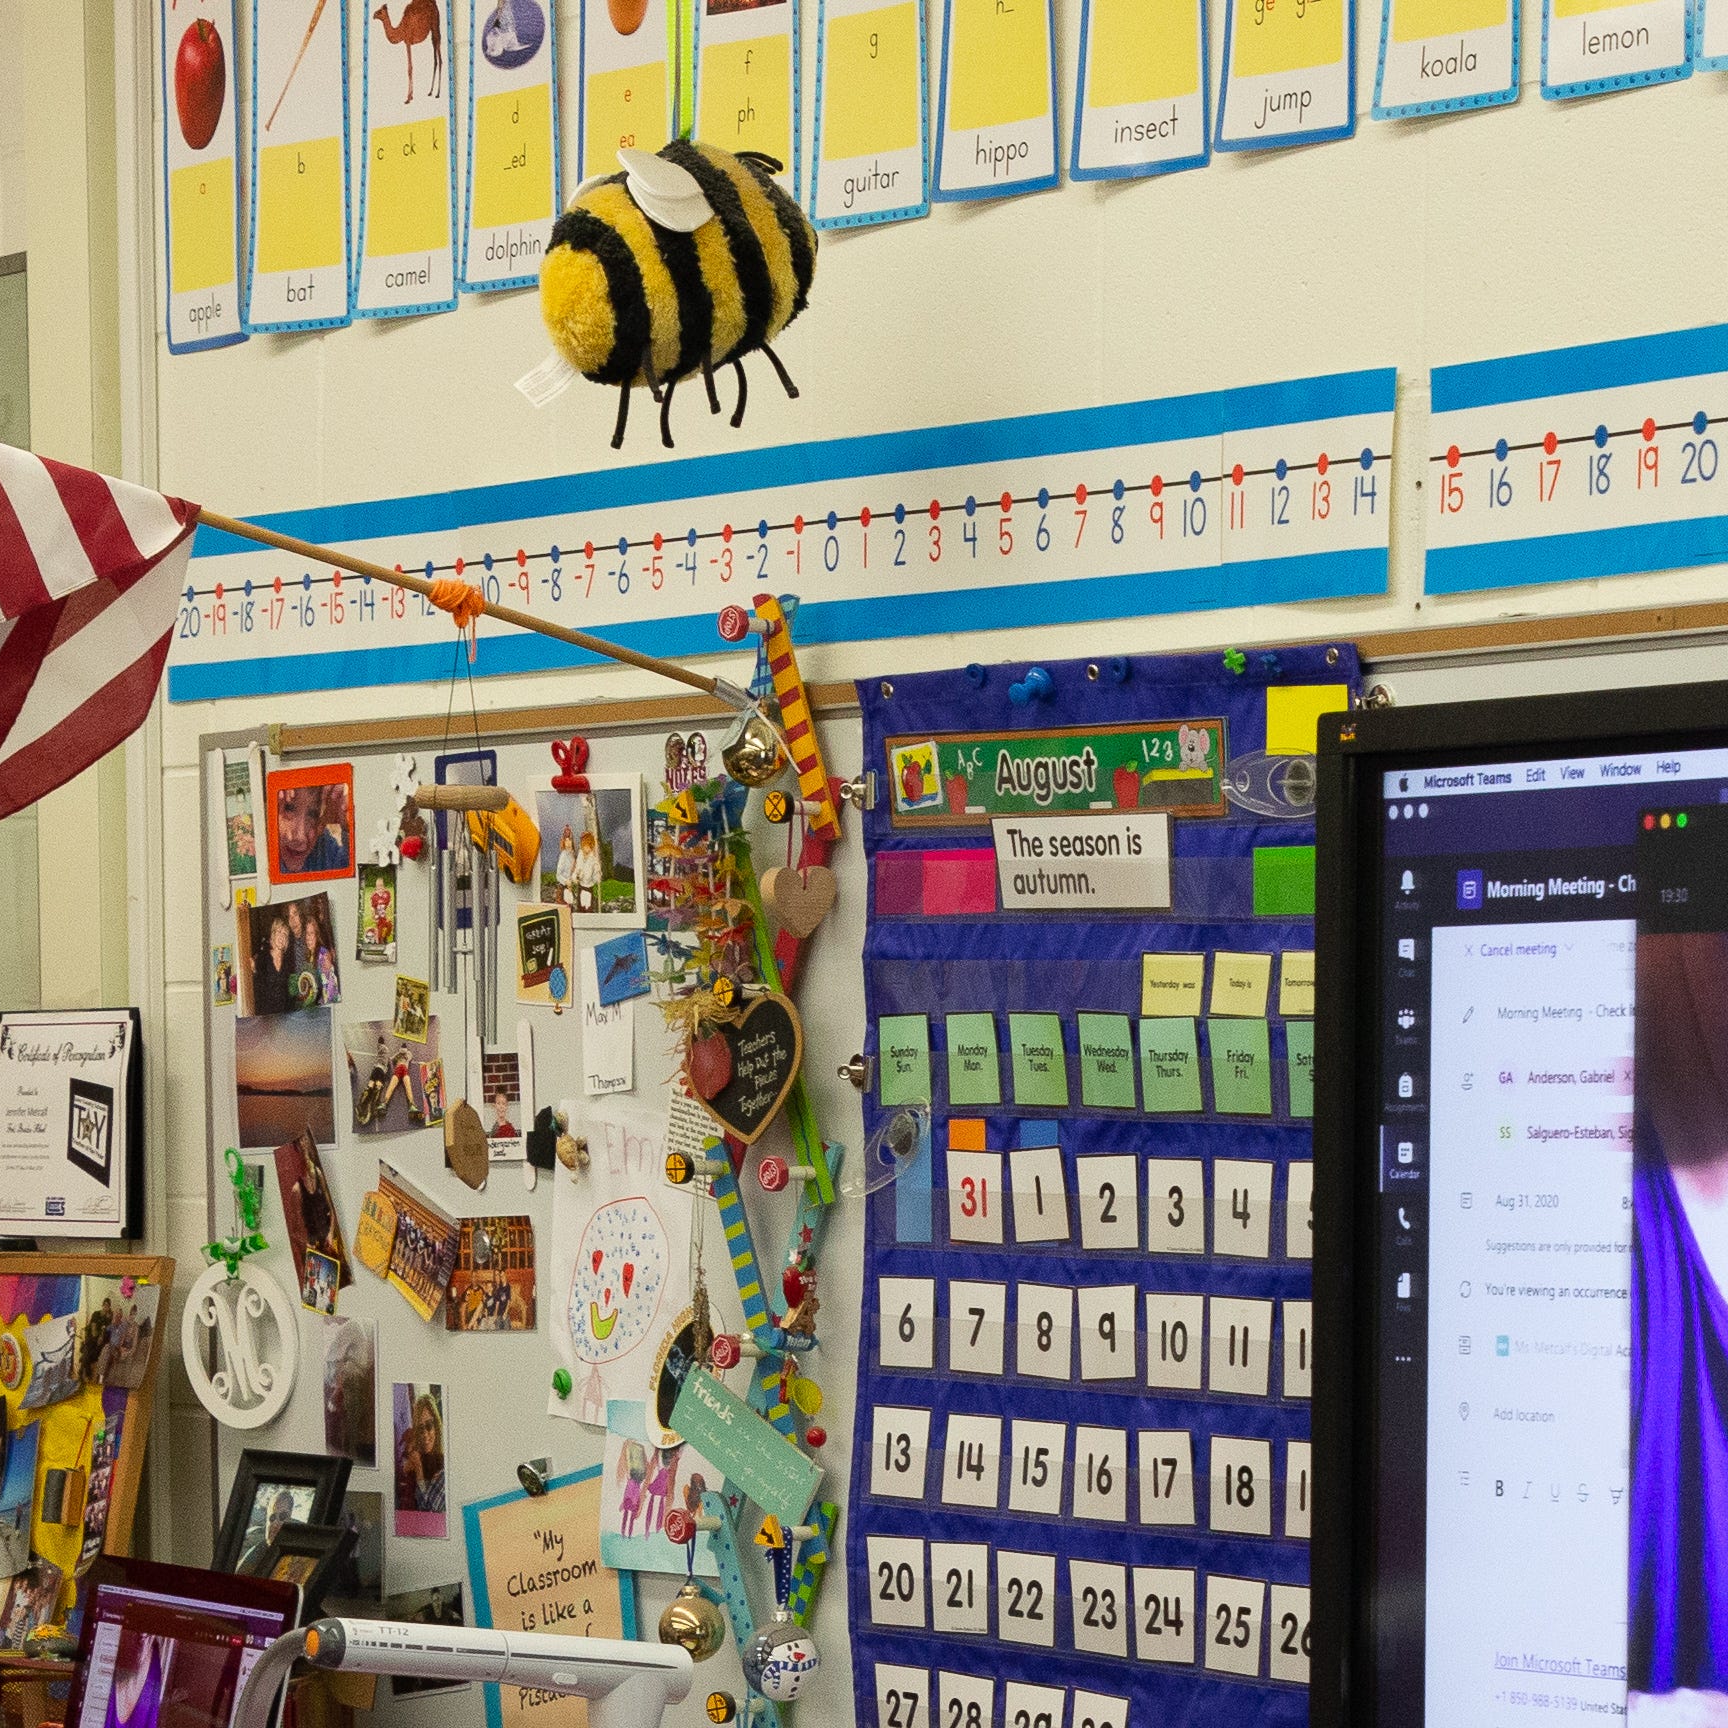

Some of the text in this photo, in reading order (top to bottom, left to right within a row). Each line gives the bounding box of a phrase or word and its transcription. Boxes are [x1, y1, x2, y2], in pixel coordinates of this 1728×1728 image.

[1581, 22, 1649, 54] lemon
[1419, 47, 1477, 78] koala
[1254, 86, 1311, 127] jump
[1114, 105, 1178, 143] insect
[975, 136, 1029, 177] hippo
[844, 166, 899, 194] guitar
[485, 233, 542, 270] dolphin
[384, 257, 430, 287] camel
[285, 280, 314, 302] bat
[189, 299, 223, 331] apple
[995, 744, 1096, 805] August
[1424, 760, 1681, 787] Microsoft Teams Edit View Window Help
[1007, 819, 1141, 857] The season is
[1013, 868, 1096, 896] autumn.
[1487, 877, 1604, 899] Morning Meeting
[1480, 943, 1556, 956] Cancel meeting
[889, 1044, 917, 1061] Sunday
[957, 1043, 987, 1060] Monday
[1022, 1043, 1054, 1060] Tuesday
[1083, 1043, 1128, 1061] Wednesday
[1148, 1049, 1188, 1066] Thursday
[1226, 1049, 1254, 1066] Friday
[1528, 1070, 1614, 1084] Anderson, Gabriel
[960, 1175, 1250, 1227] 31 1 2 3 4
[506, 1560, 596, 1595] Classroom
[521, 1599, 593, 1630] is like a
[378, 1625, 409, 1636] TT-12
